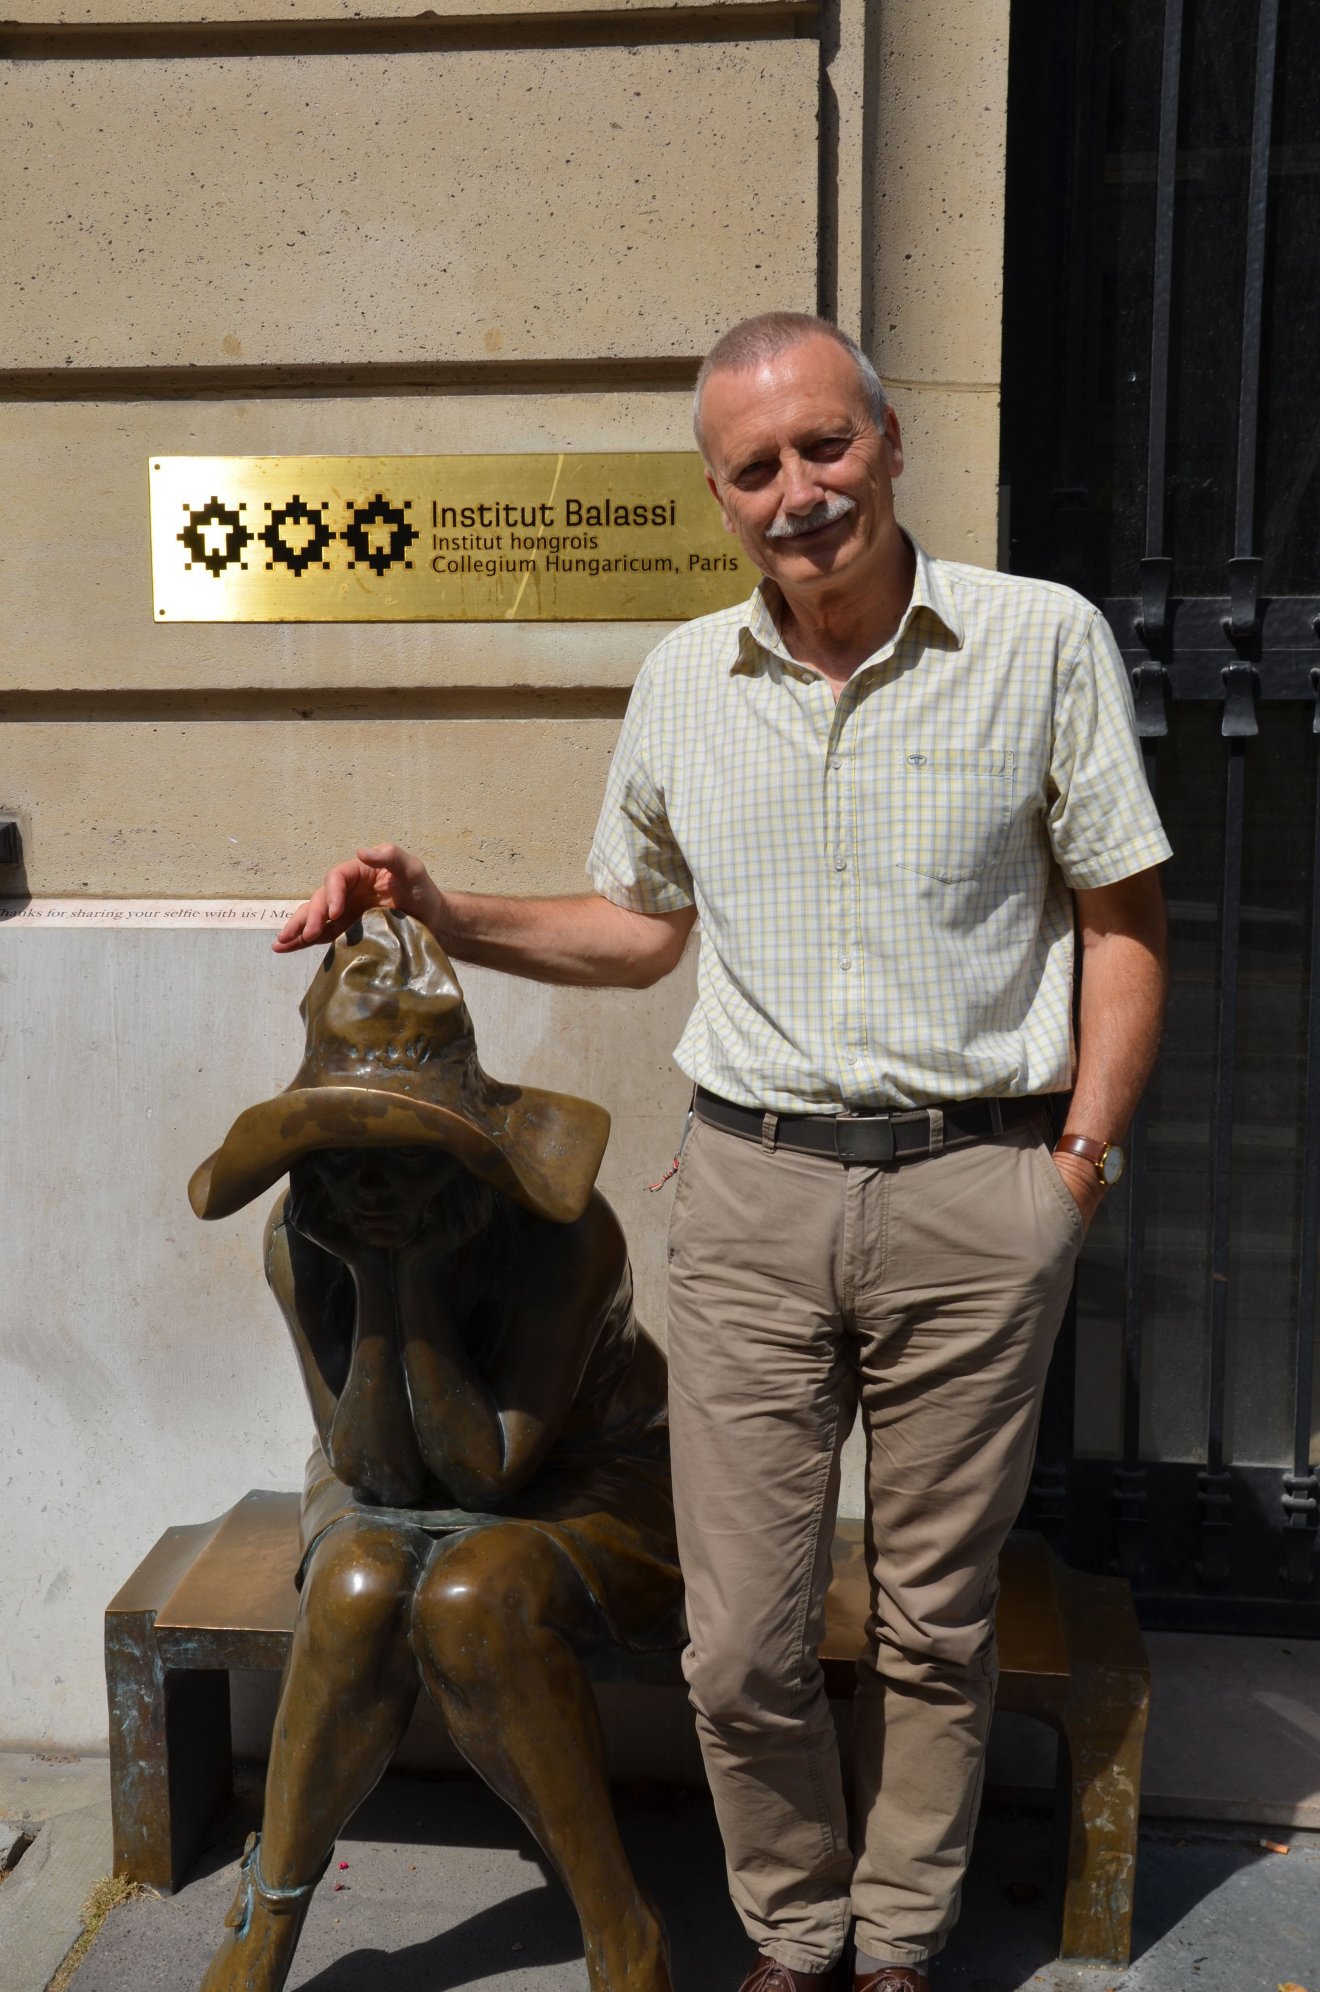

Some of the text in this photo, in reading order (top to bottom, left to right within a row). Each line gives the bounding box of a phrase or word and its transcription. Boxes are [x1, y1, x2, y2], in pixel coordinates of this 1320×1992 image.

[432, 499, 676, 528] Institut Balassi
[433, 532, 598, 553] Institut hongrois
[432, 555, 738, 577] Collegium Hungaricum, Paris
[0, 908, 43, 917] hanks
[47, 908, 67, 918] for
[70, 909, 123, 920] sharing
[125, 911, 160, 920] your
[164, 908, 200, 918] selfie
[205, 909, 236, 918] with
